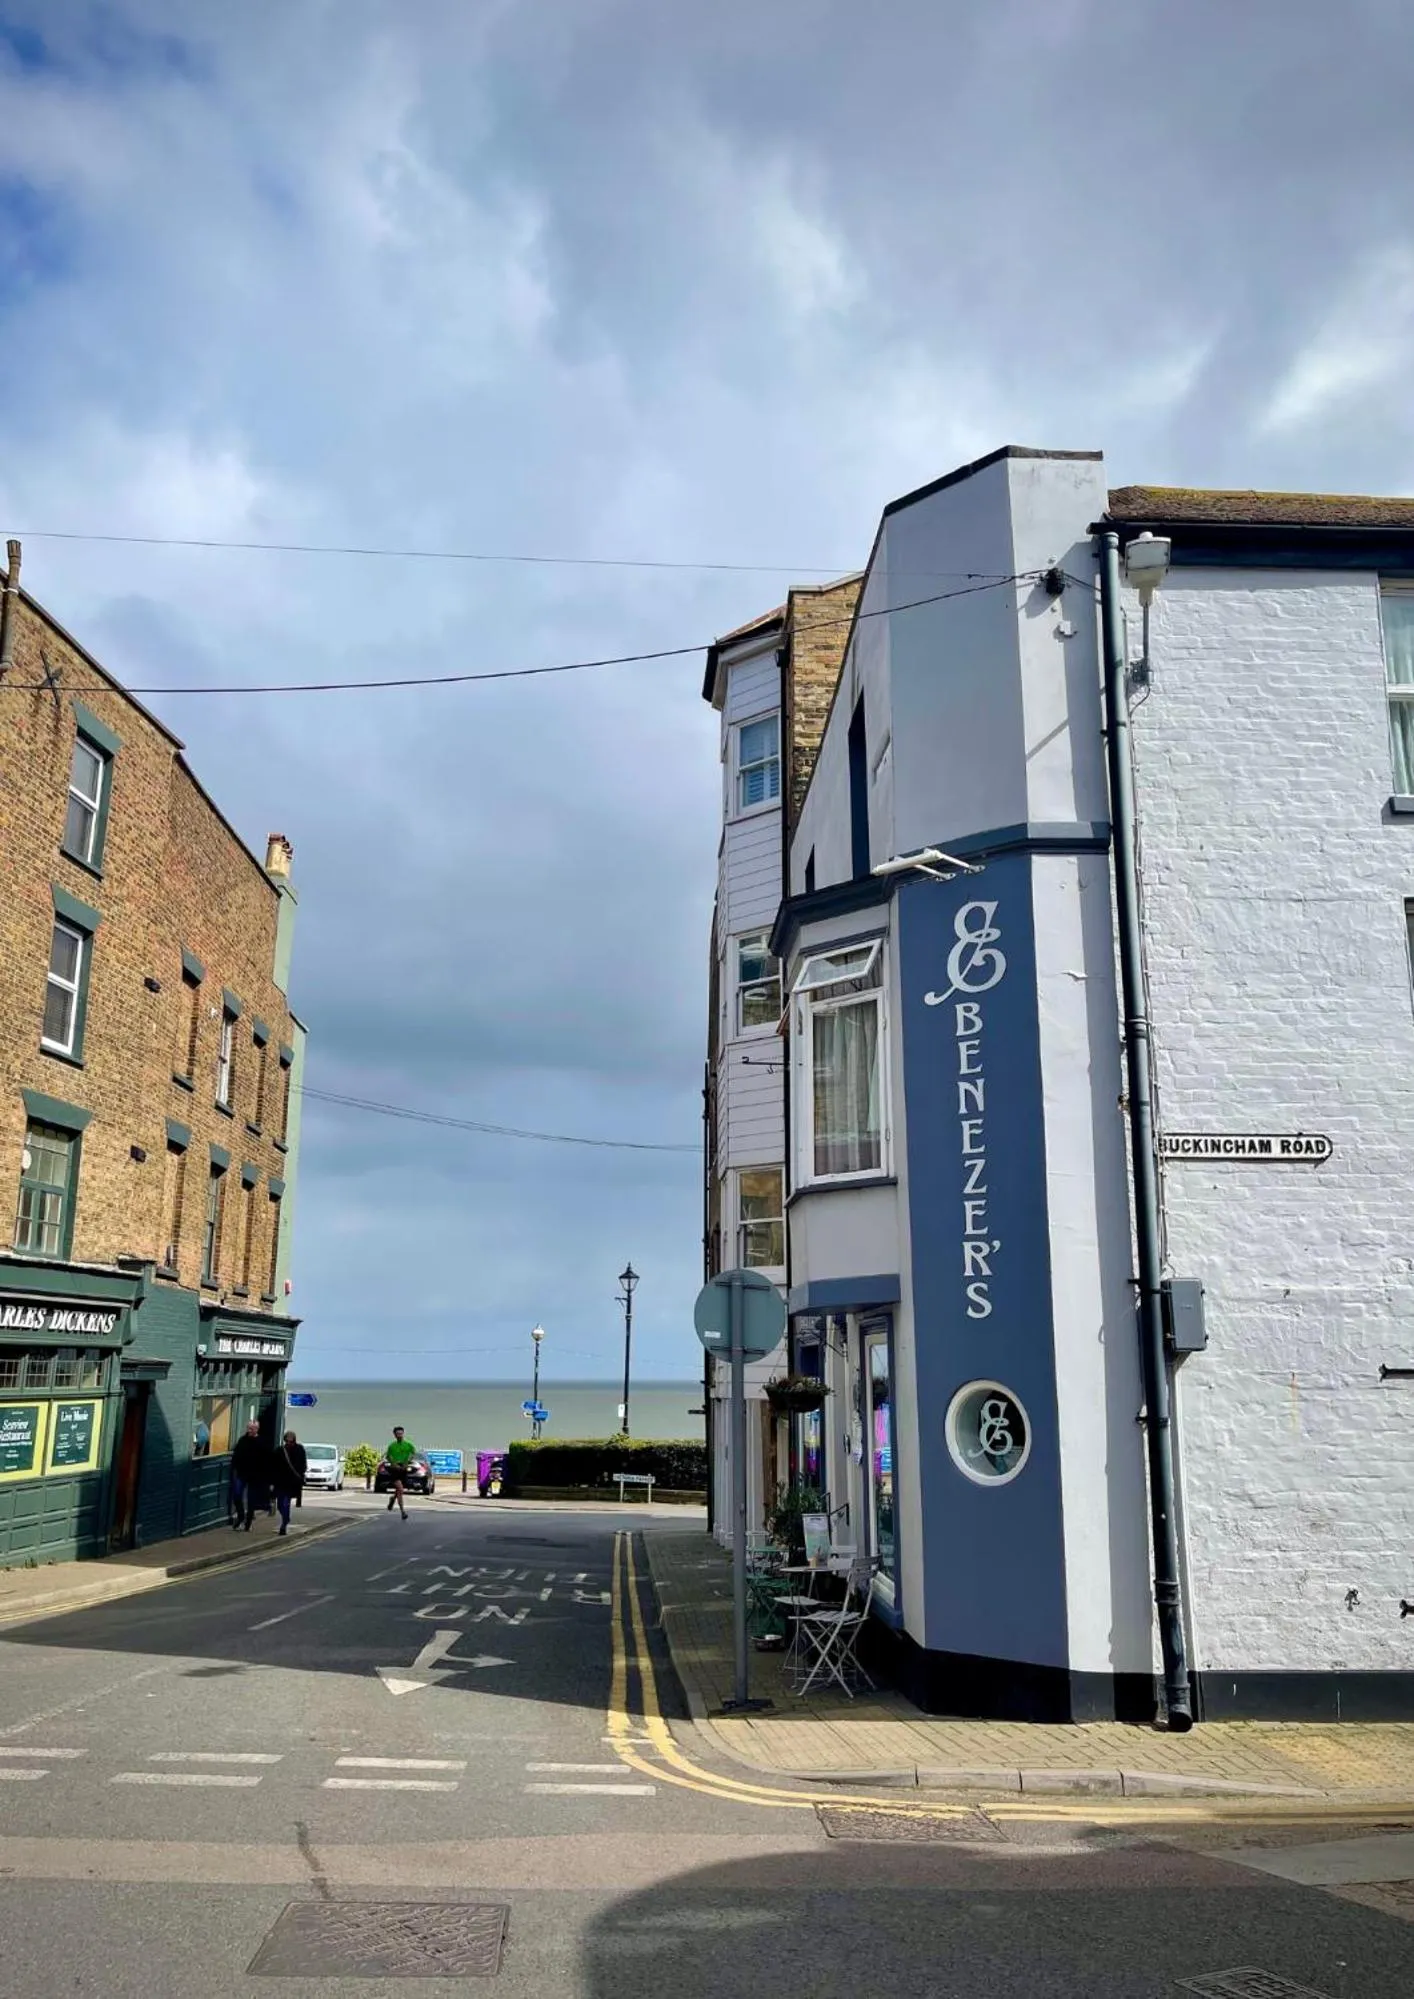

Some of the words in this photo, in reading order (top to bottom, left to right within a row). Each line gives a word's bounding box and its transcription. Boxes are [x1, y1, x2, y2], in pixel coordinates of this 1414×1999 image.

[1280, 1139, 1327, 1154] ROAD
[48, 1309, 117, 1334] DICKENS
[413, 1602, 532, 1625] NO
